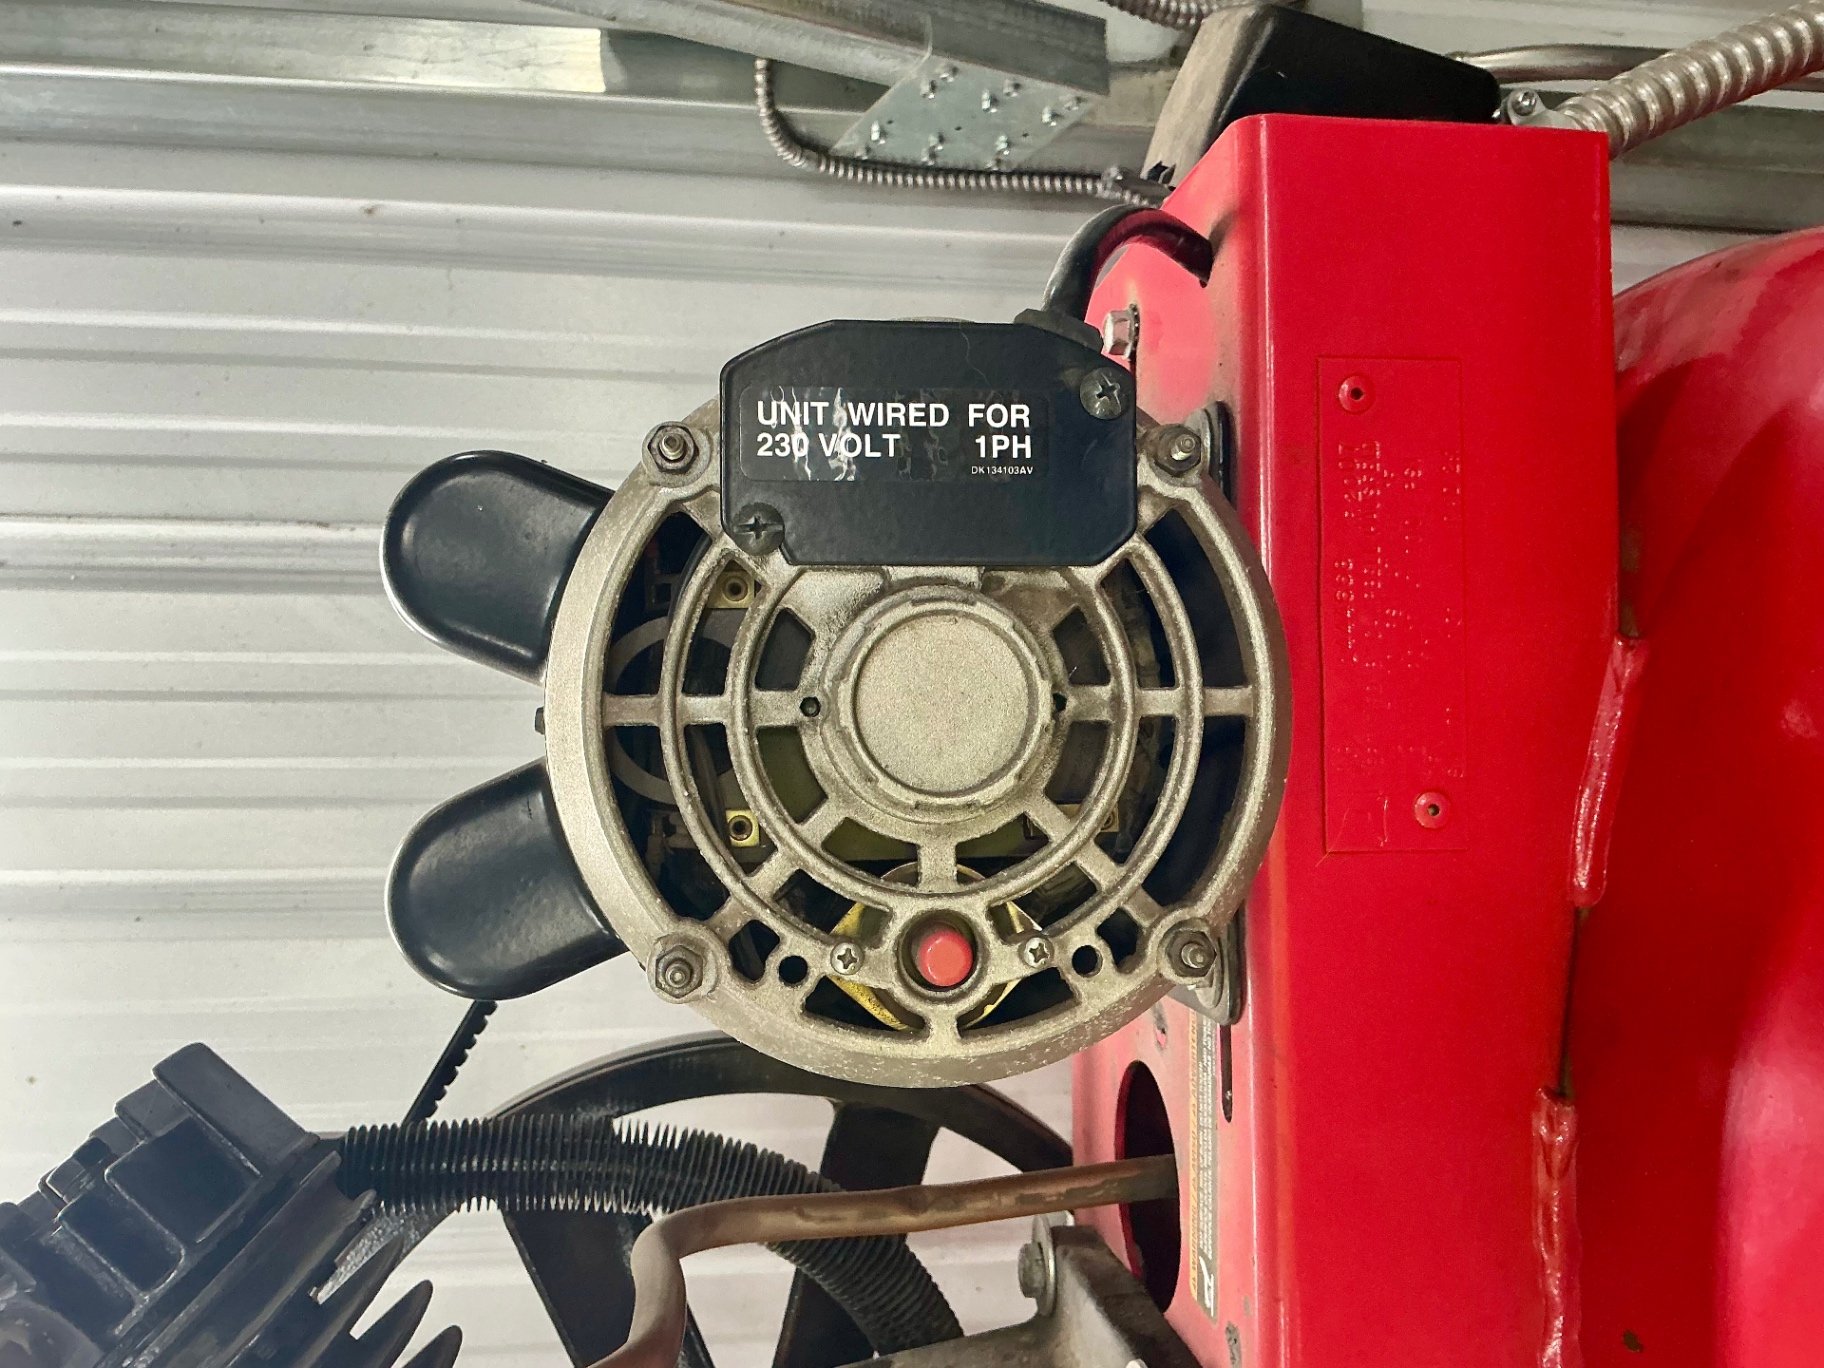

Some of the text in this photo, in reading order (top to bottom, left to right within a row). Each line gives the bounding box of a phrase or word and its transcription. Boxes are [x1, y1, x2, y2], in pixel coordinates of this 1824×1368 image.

[757, 401, 1030, 428] UNIT WIRED FOR
[757, 432, 1032, 459] 230 VOLT 1PH
[971, 465, 1034, 475] DK134103AV
